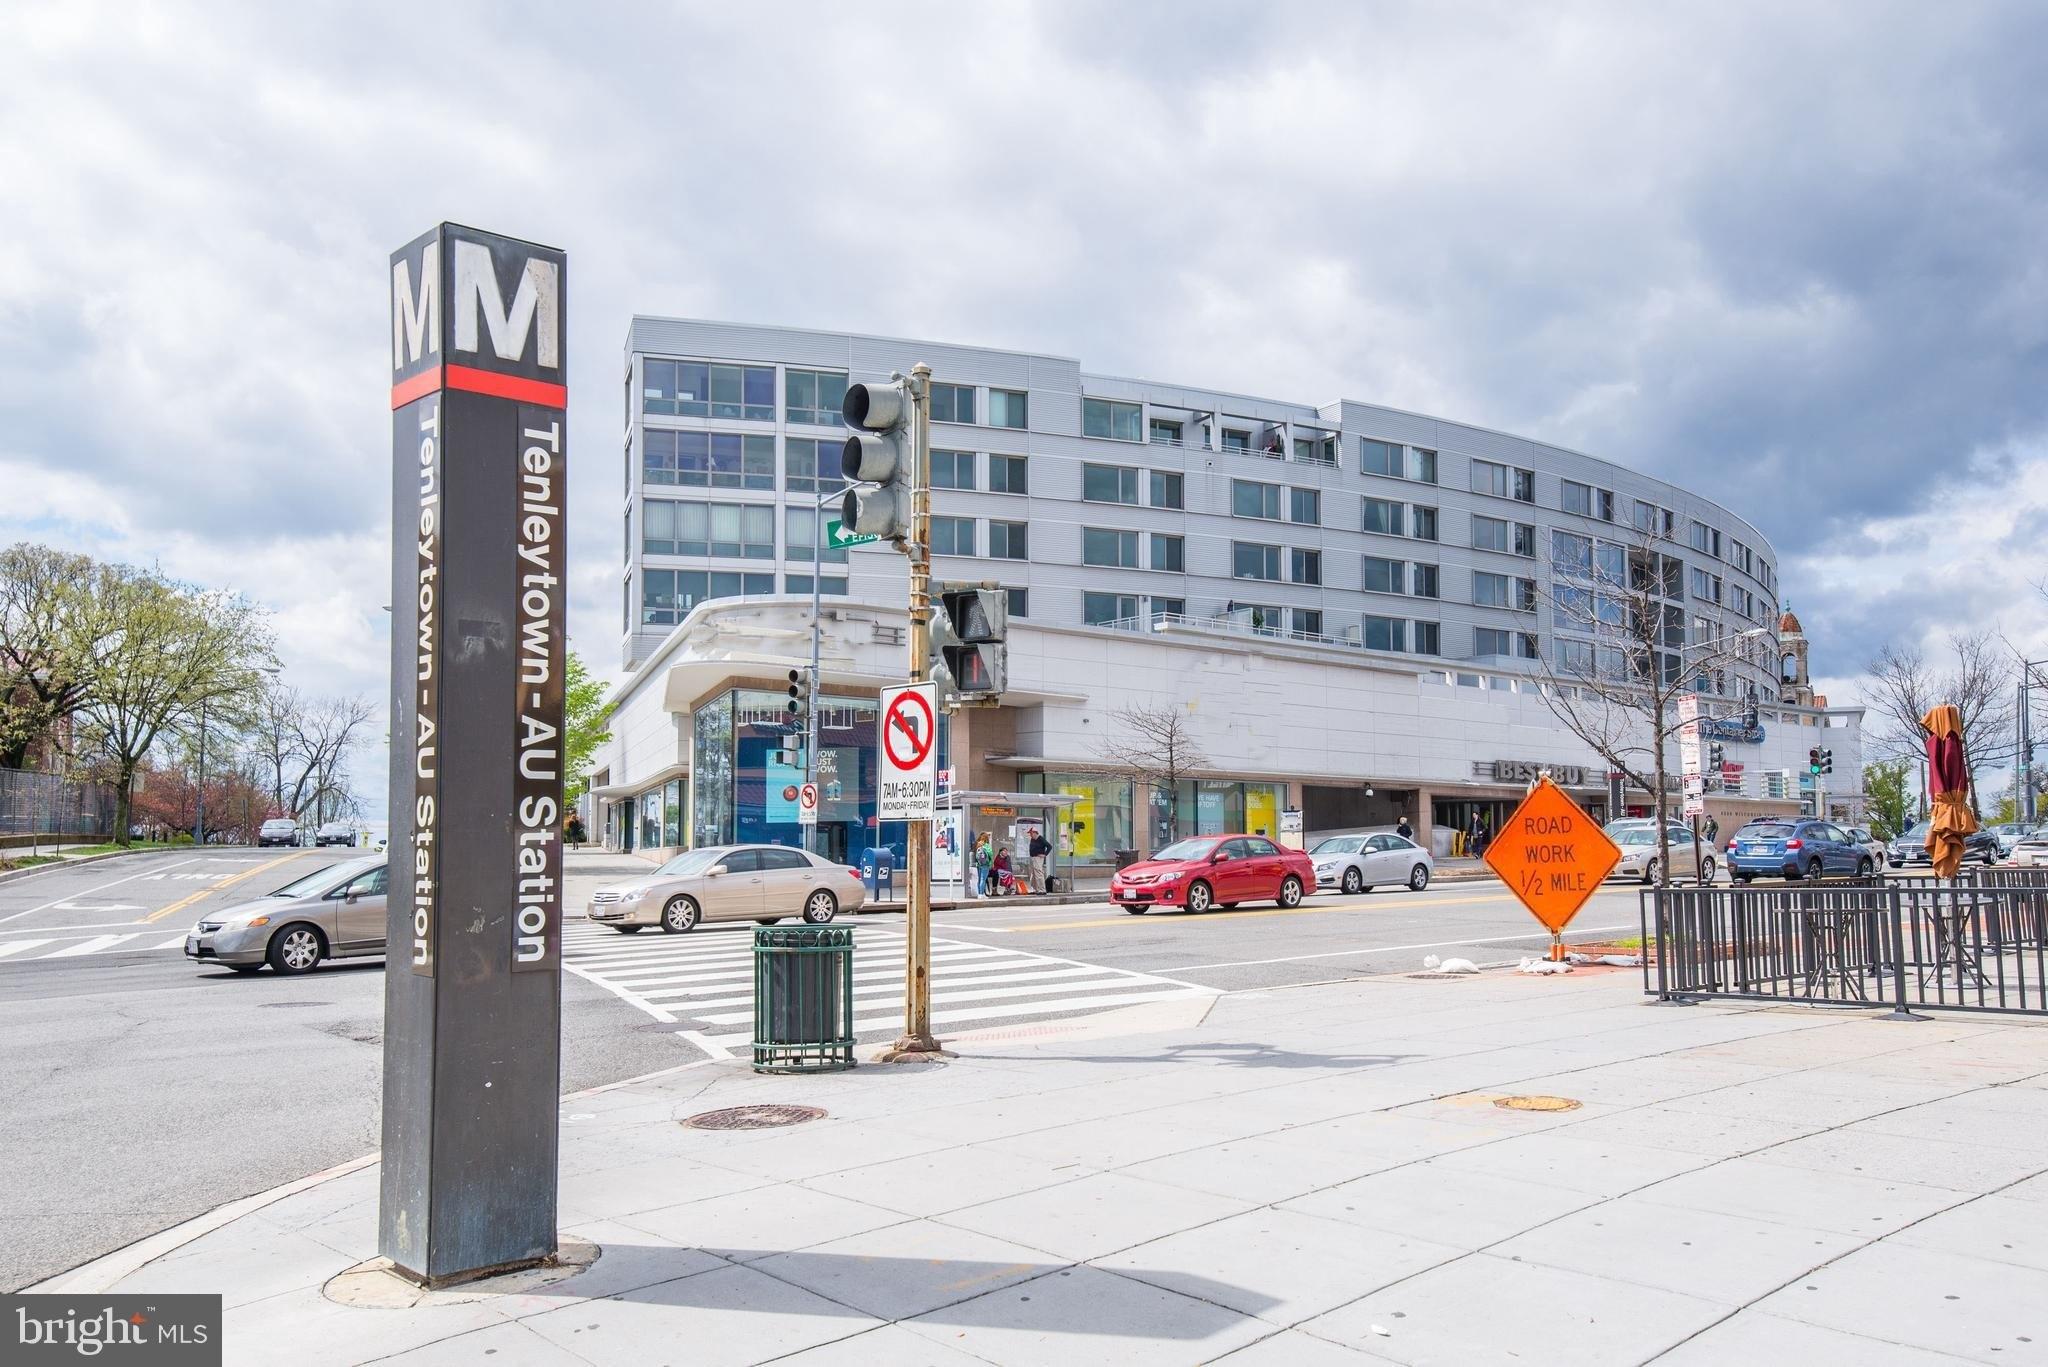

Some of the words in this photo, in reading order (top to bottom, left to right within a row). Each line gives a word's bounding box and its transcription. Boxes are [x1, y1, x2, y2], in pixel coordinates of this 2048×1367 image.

[393, 240, 438, 371] M
[455, 239, 558, 369] M
[1552, 764, 1591, 787] BUY
[883, 781, 931, 799] 7AM-6:30PM
[883, 800, 929, 811] MONDAY-FRIDAY
[1525, 816, 1572, 835] ROAD
[1525, 844, 1576, 864] WORK
[413, 795, 435, 966] Station
[517, 795, 557, 963] Station
[1551, 873, 1587, 892] MILE
